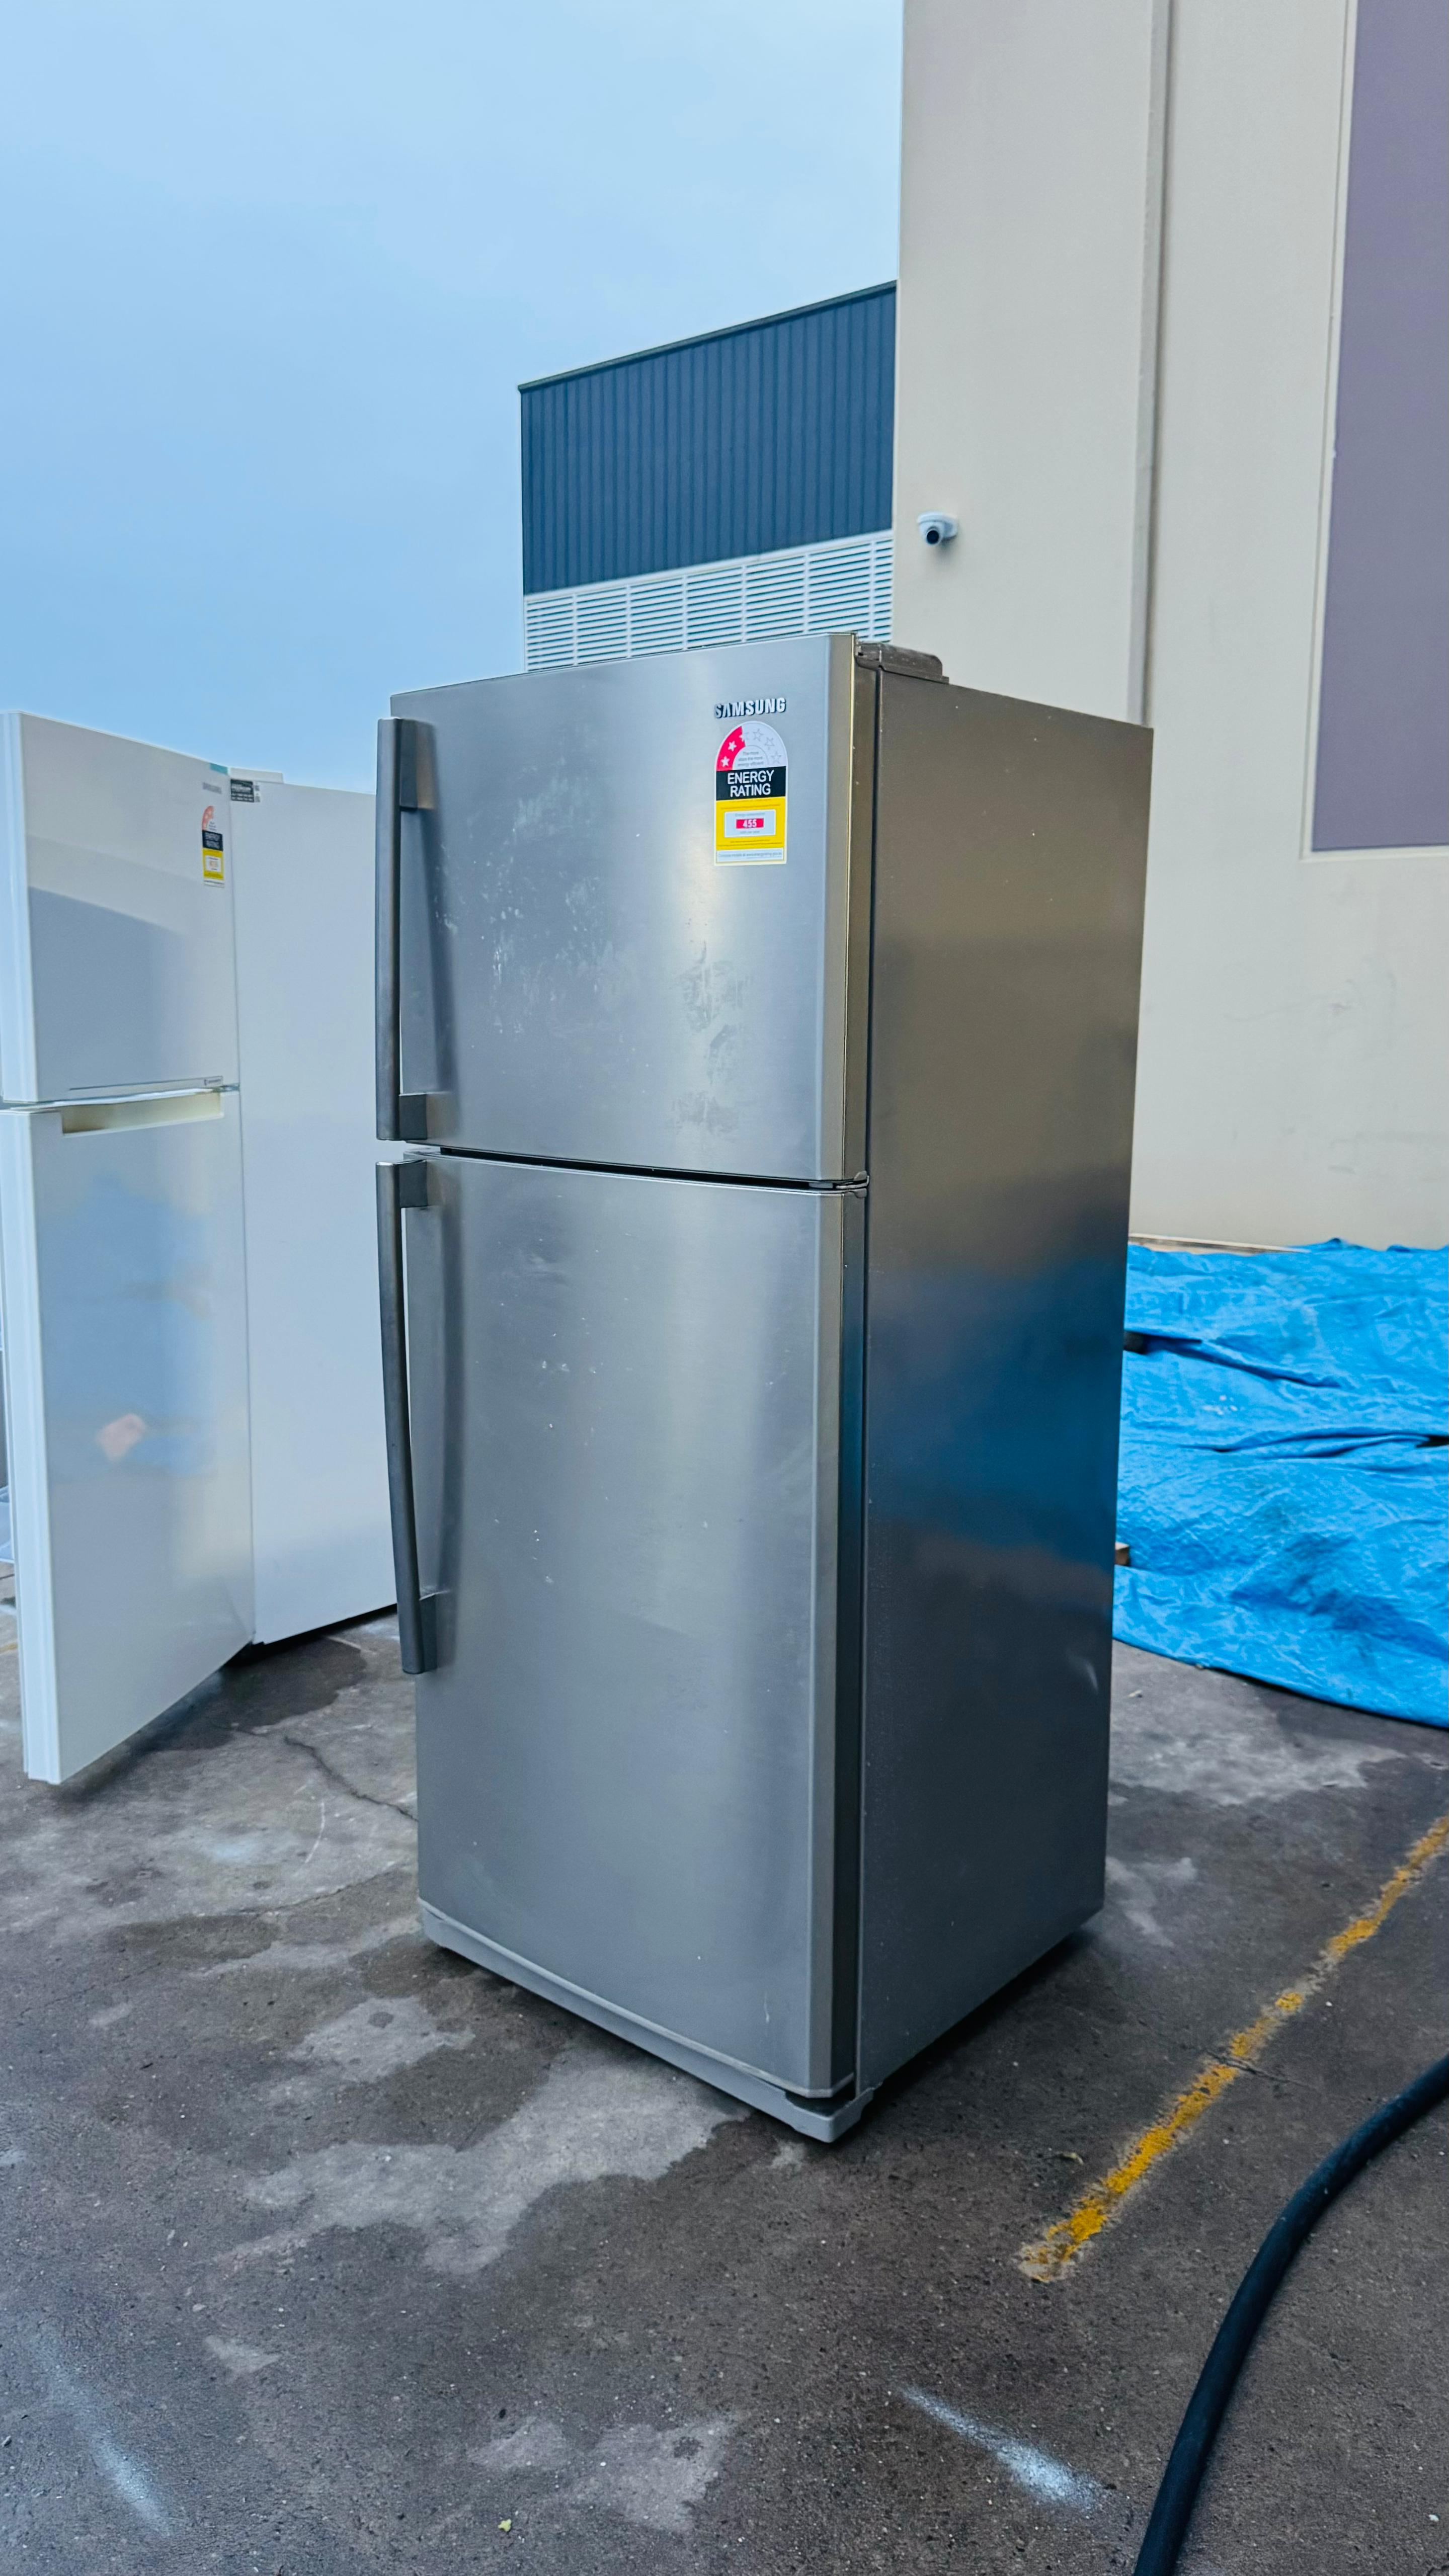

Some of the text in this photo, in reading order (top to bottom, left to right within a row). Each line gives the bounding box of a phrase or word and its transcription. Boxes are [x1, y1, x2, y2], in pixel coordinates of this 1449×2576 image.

[714, 697, 786, 718] SAMSUNG
[728, 770, 774, 784] ENERGY
[730, 783, 771, 797] RATING
[743, 819, 757, 828] 455
